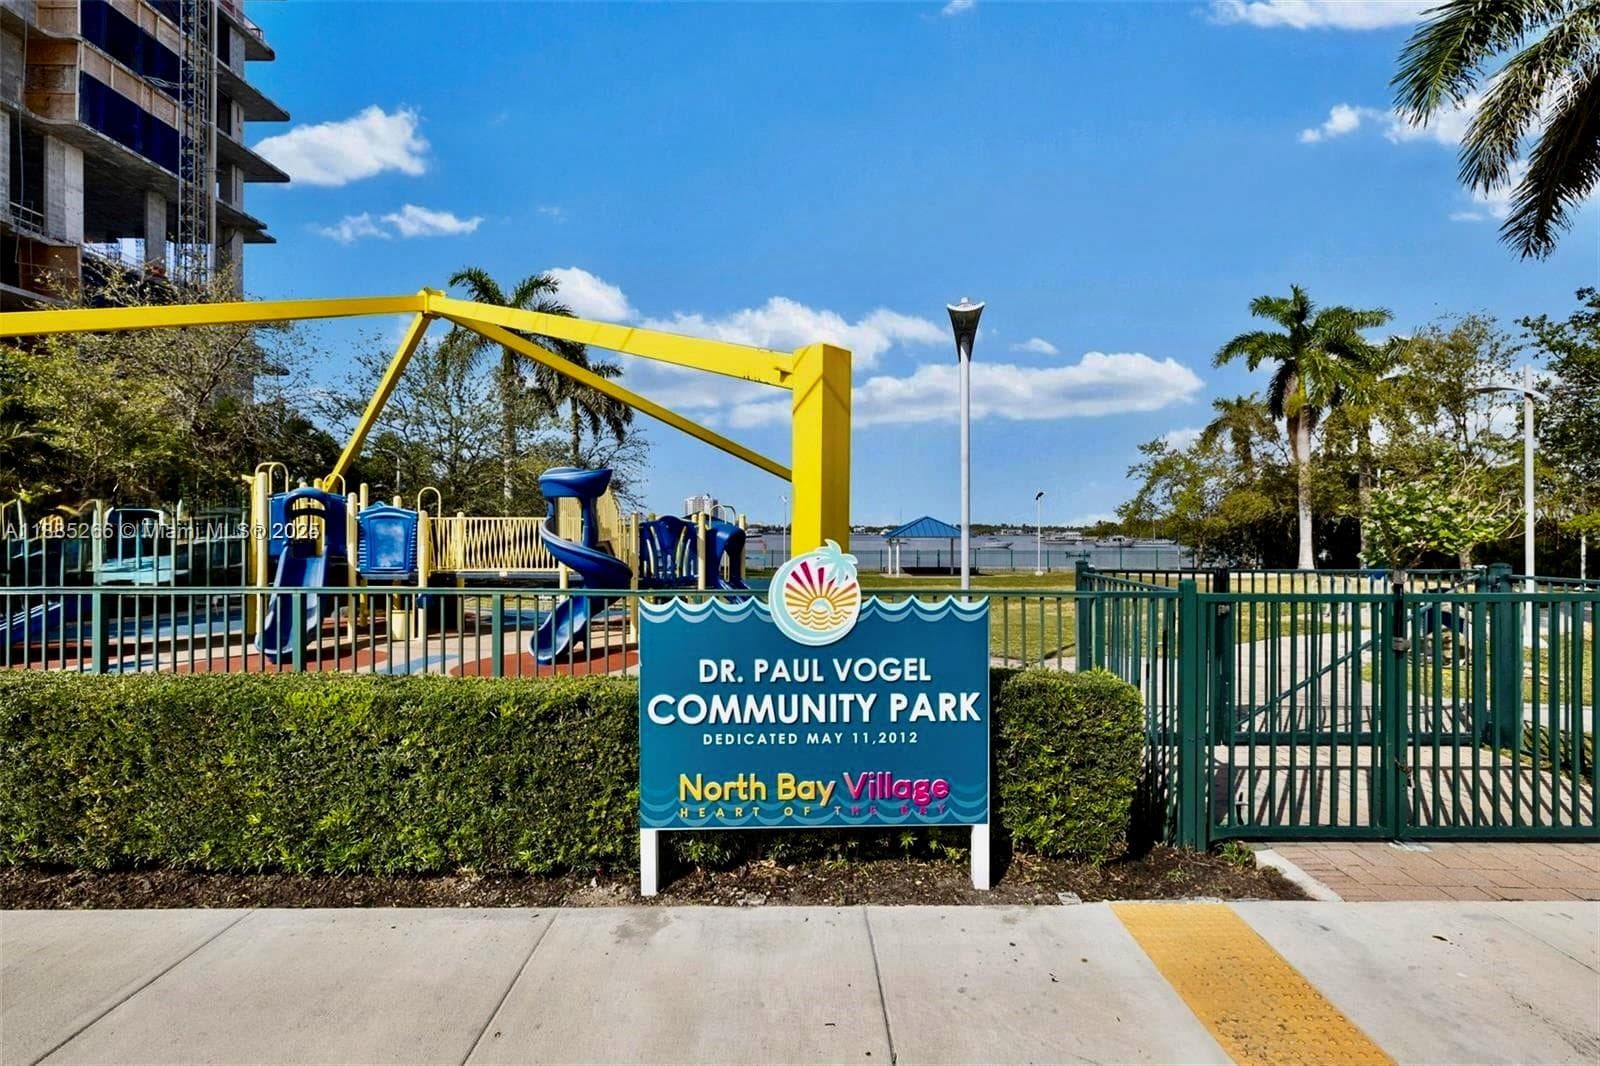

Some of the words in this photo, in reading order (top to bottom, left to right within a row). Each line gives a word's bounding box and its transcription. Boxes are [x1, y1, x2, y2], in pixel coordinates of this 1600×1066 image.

[699, 658, 744, 684] DR.
[754, 658, 824, 683] PAUL
[832, 657, 931, 682] VOGEL
[647, 693, 877, 725] COMMUNITY
[889, 692, 982, 723] PARK
[703, 732, 798, 746] DEDICATED
[806, 732, 843, 745] MAY
[852, 731, 919, 746] 11,2012
[679, 773, 767, 802] North
[776, 772, 837, 807] Bay
[842, 771, 950, 807] Village
[679, 807, 761, 818] HEART
[783, 806, 812, 817] OF
[833, 805, 878, 817] THE
